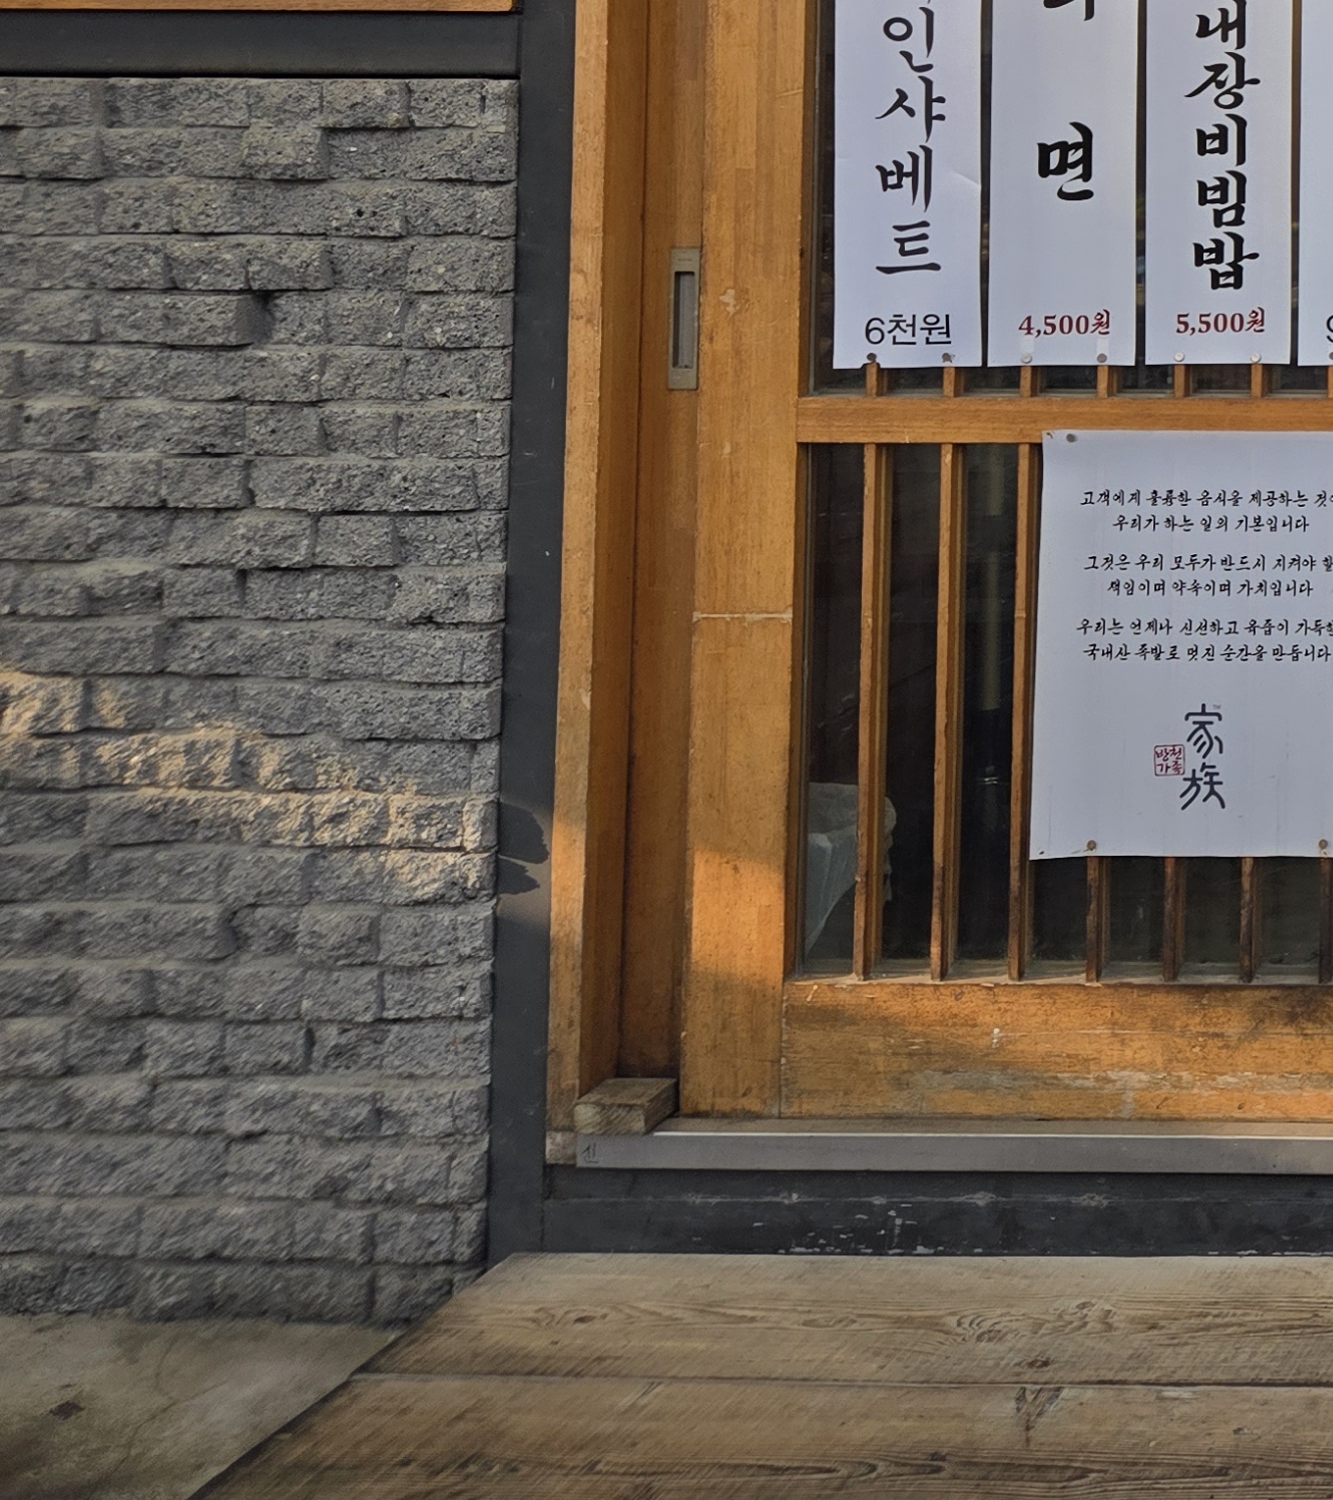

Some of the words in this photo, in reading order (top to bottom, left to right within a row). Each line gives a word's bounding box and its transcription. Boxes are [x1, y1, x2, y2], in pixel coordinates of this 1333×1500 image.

[863, 312, 953, 347] 6천원
[1018, 309, 1111, 338] 4,500원
[1175, 306, 1266, 336] 5,500원
[1080, 489, 1141, 507] 고객에게
[1196, 489, 1243, 507] 음식을
[1248, 489, 1308, 507] 제공하는
[1112, 514, 1159, 532] 우리가
[1164, 514, 1194, 532] 하는
[1200, 514, 1228, 532] 일의
[1234, 514, 1309, 532] 기본입니다
[1084, 554, 1130, 571] 그것은
[1134, 554, 1164, 571] 우리
[1170, 554, 1216, 571] 모두가
[1220, 554, 1266, 571] 반드시
[1272, 554, 1316, 571] 지켜야
[1172, 579, 1231, 597] 약속이며
[1236, 579, 1314, 597] 가치입니다
[1076, 618, 1124, 636] 우리는
[1129, 618, 1173, 636] 언제나
[1179, 618, 1239, 636] 신선하고
[1083, 643, 1130, 661] 국내산
[1186, 643, 1215, 661] 멋진
[1220, 643, 1267, 661] 순간을
[1271, 643, 1331, 661] 만듭니다
